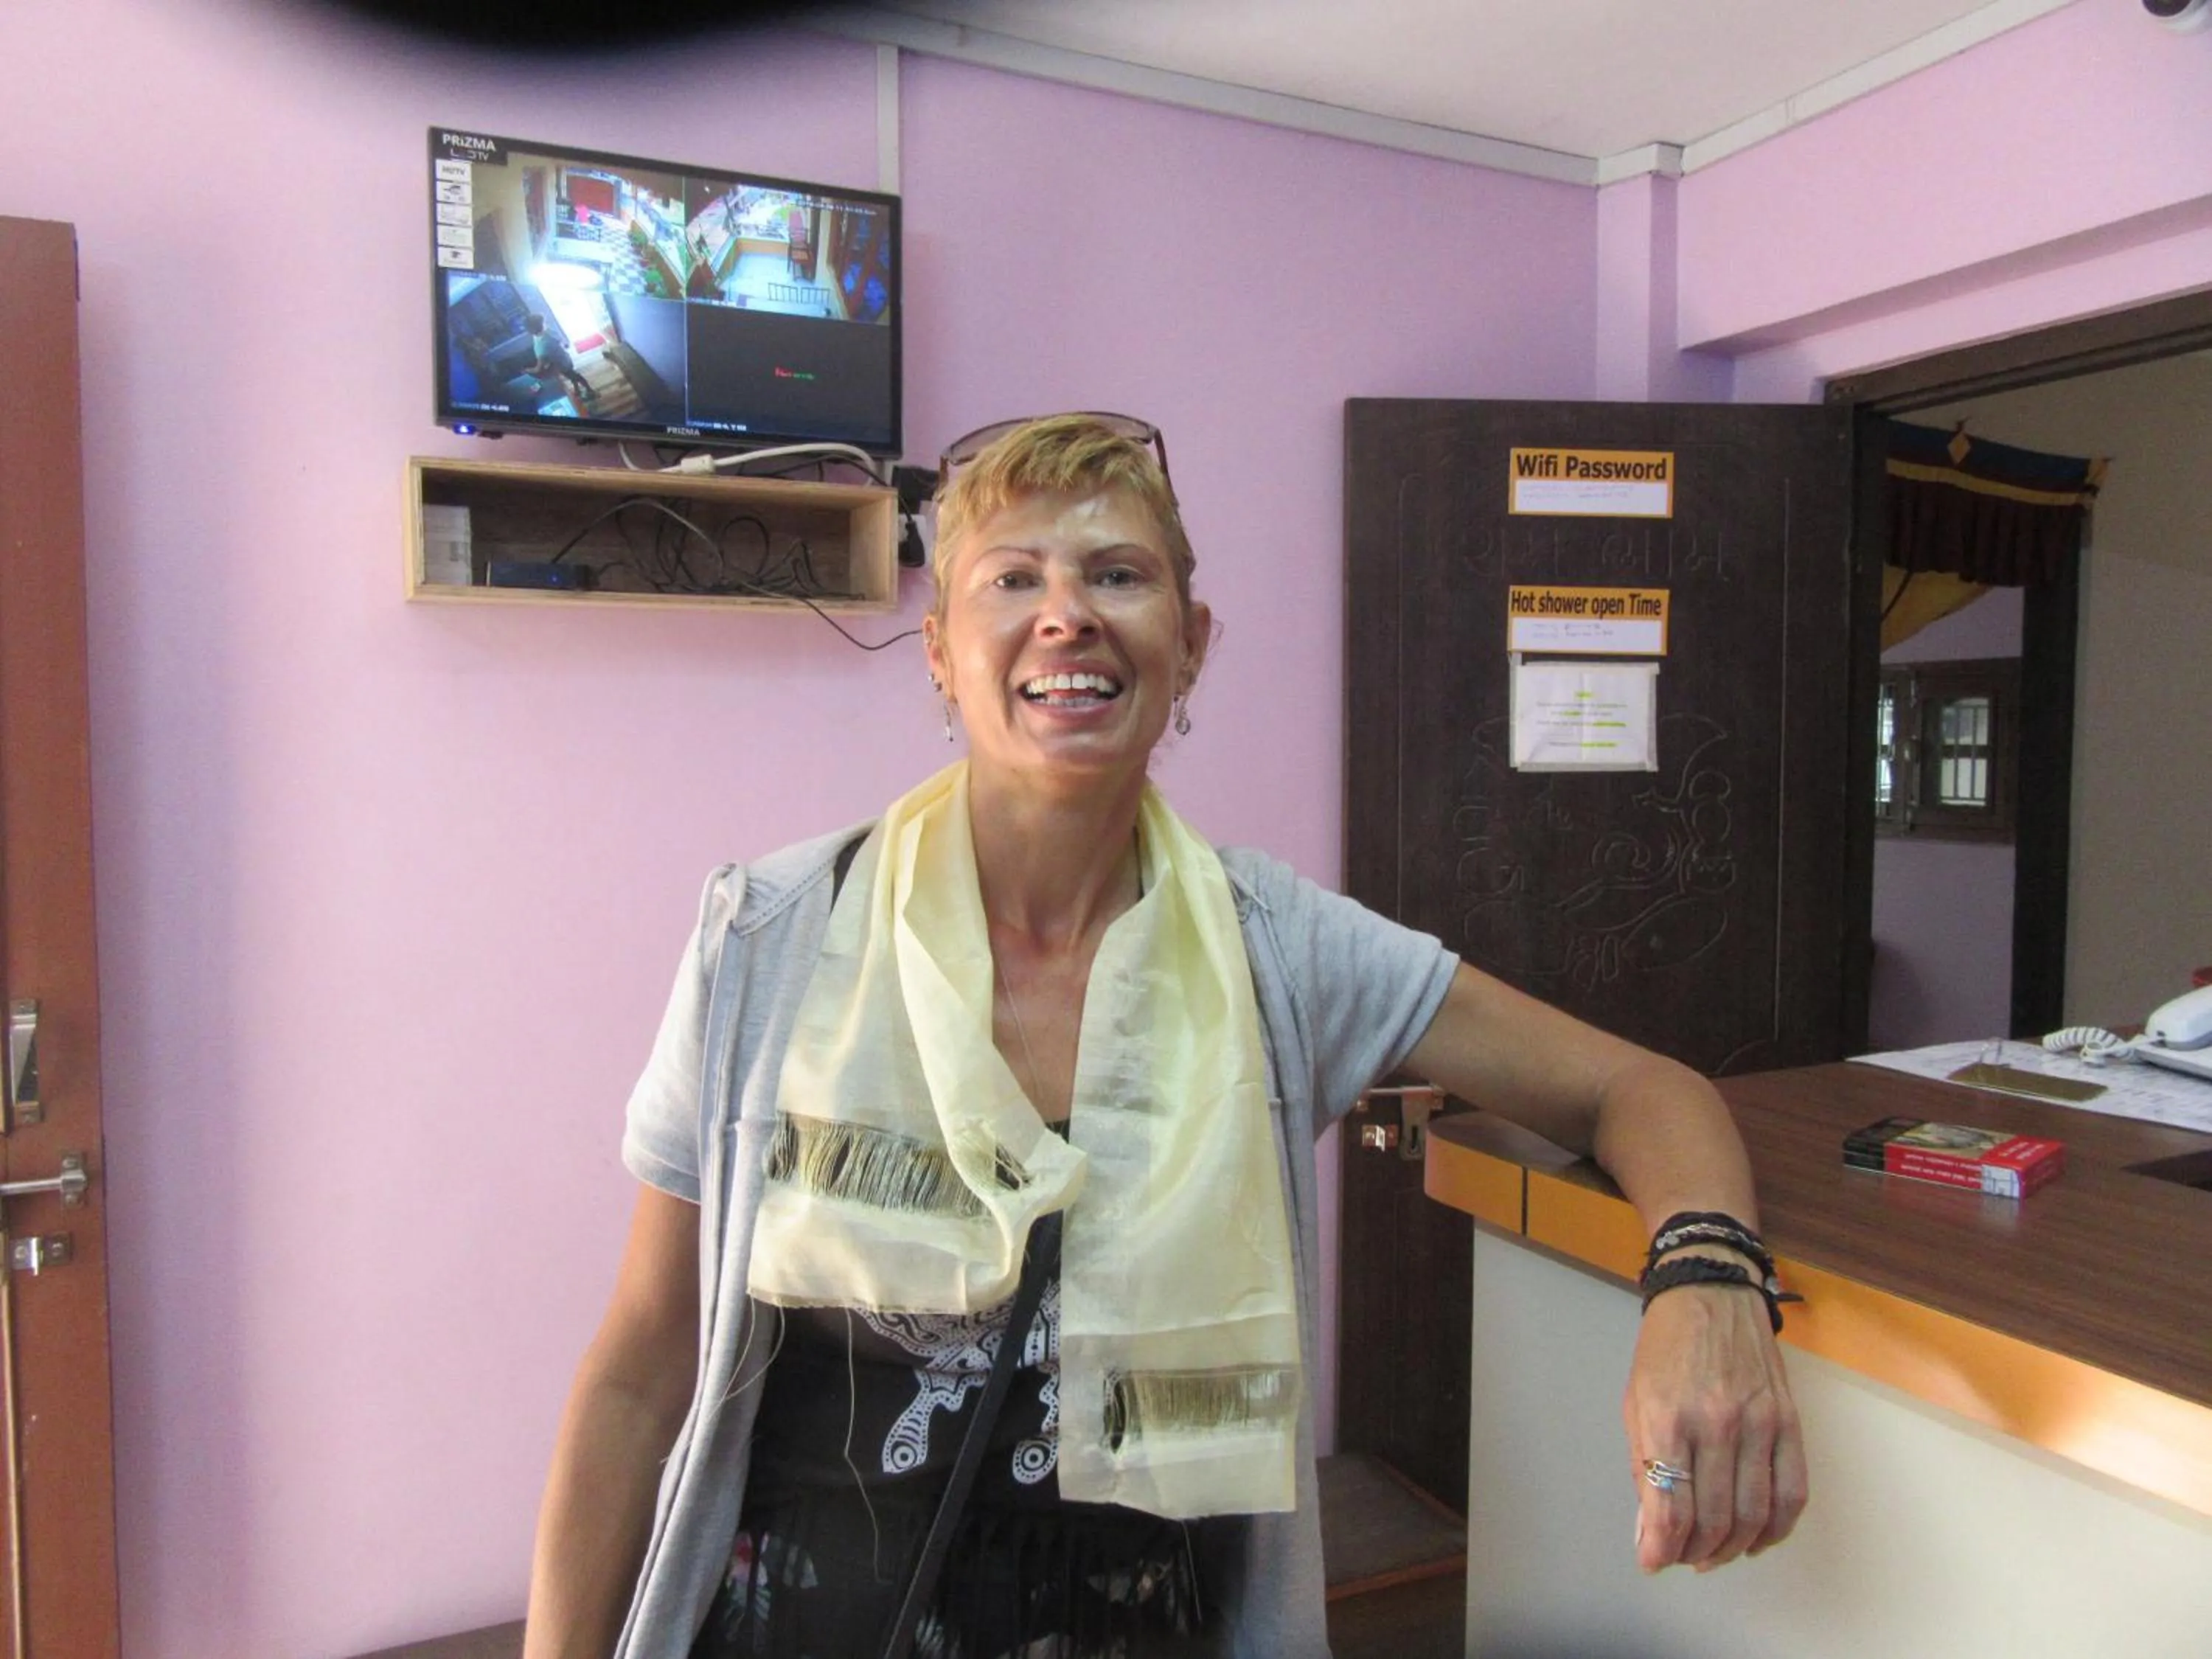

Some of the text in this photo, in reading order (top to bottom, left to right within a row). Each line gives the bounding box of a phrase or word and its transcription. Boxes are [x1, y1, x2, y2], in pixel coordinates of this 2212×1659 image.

[1517, 454, 1667, 480] Wifi Password
[1512, 591, 1661, 619] Hot shower open Time
